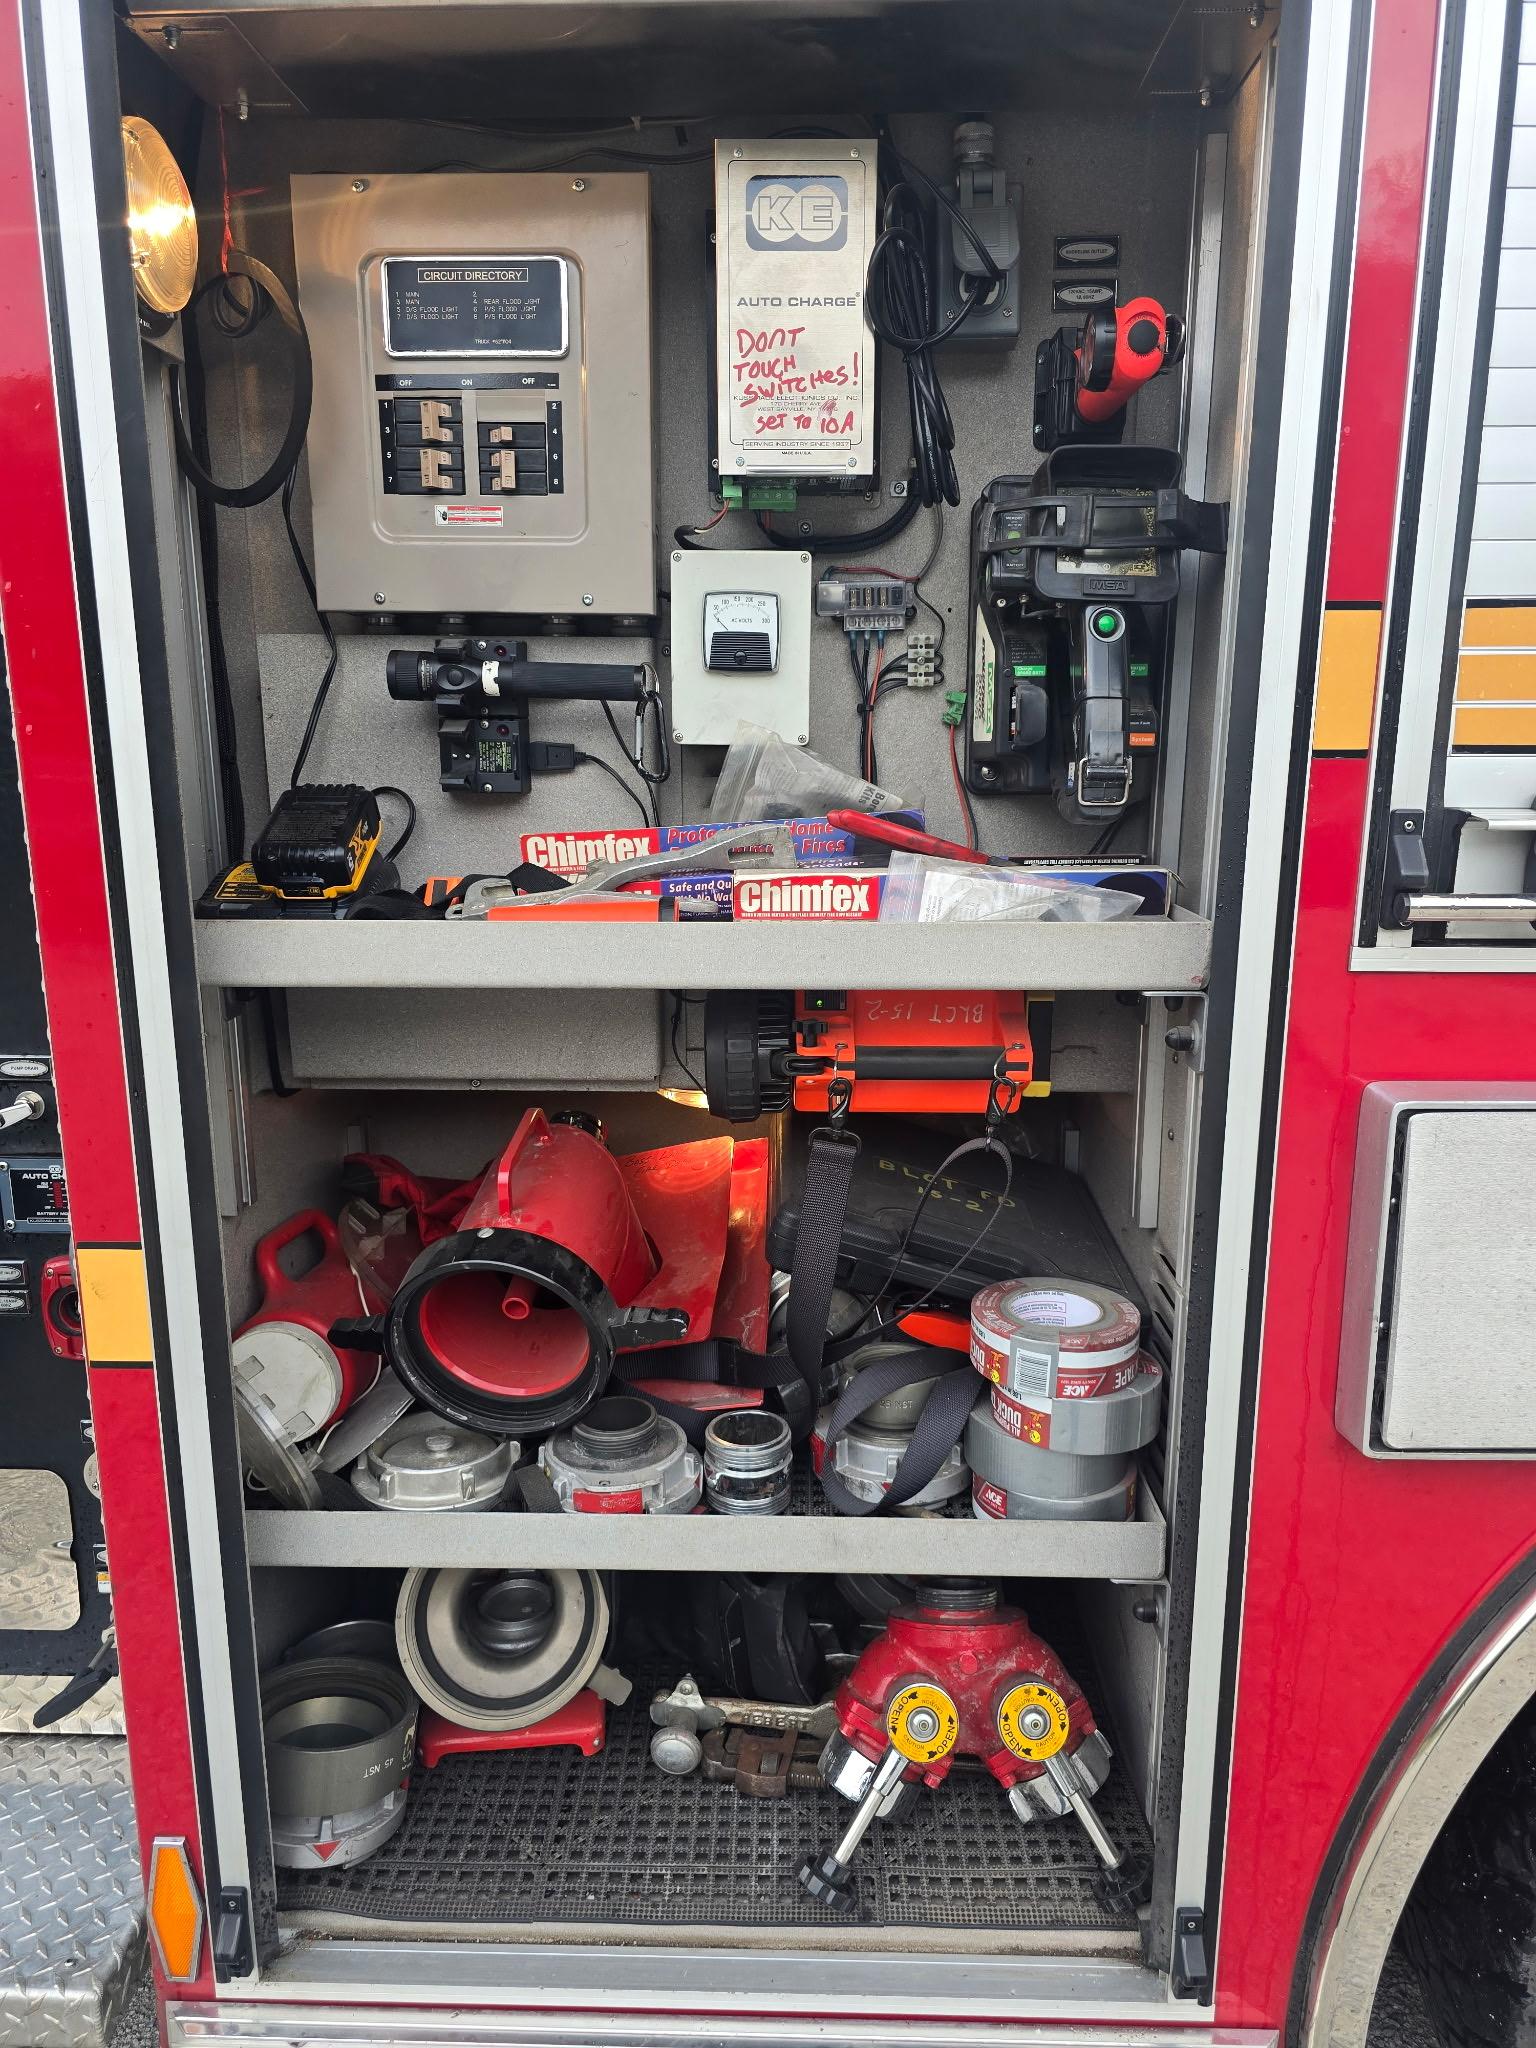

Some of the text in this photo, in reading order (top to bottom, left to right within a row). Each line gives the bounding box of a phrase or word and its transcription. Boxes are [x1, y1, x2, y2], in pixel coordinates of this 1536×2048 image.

[758, 196, 833, 230] KE
[423, 271, 522, 280] CIRCUIT DIRECTORY
[737, 298, 782, 306] AUTO
[733, 355, 796, 382] TOUCH
[793, 414, 812, 430] TO
[1090, 580, 1126, 590] MSA
[526, 834, 650, 868] Chimfex
[802, 838, 846, 854] Fires
[670, 882, 692, 892] Safe
[695, 880, 714, 889] and
[740, 880, 870, 912] Chimfex
[865, 1000, 913, 1021] 15-2
[1115, 1367, 1134, 1388] TAPE
[1062, 1385, 1089, 1397] ACE
[997, 1398, 1021, 1428] DUCK
[1011, 1425, 1020, 1437] ALL
[986, 1489, 1002, 1506] ACE
[891, 1696, 909, 1725] OPEN
[1046, 1693, 1066, 1722] OPEN
[903, 1734, 925, 1750] CAUTION
[936, 1725, 955, 1754] OPEN
[1003, 1723, 1023, 1752] OPEN
[1035, 1732, 1056, 1748] CAUTION
[363, 1764, 380, 1778] NST
